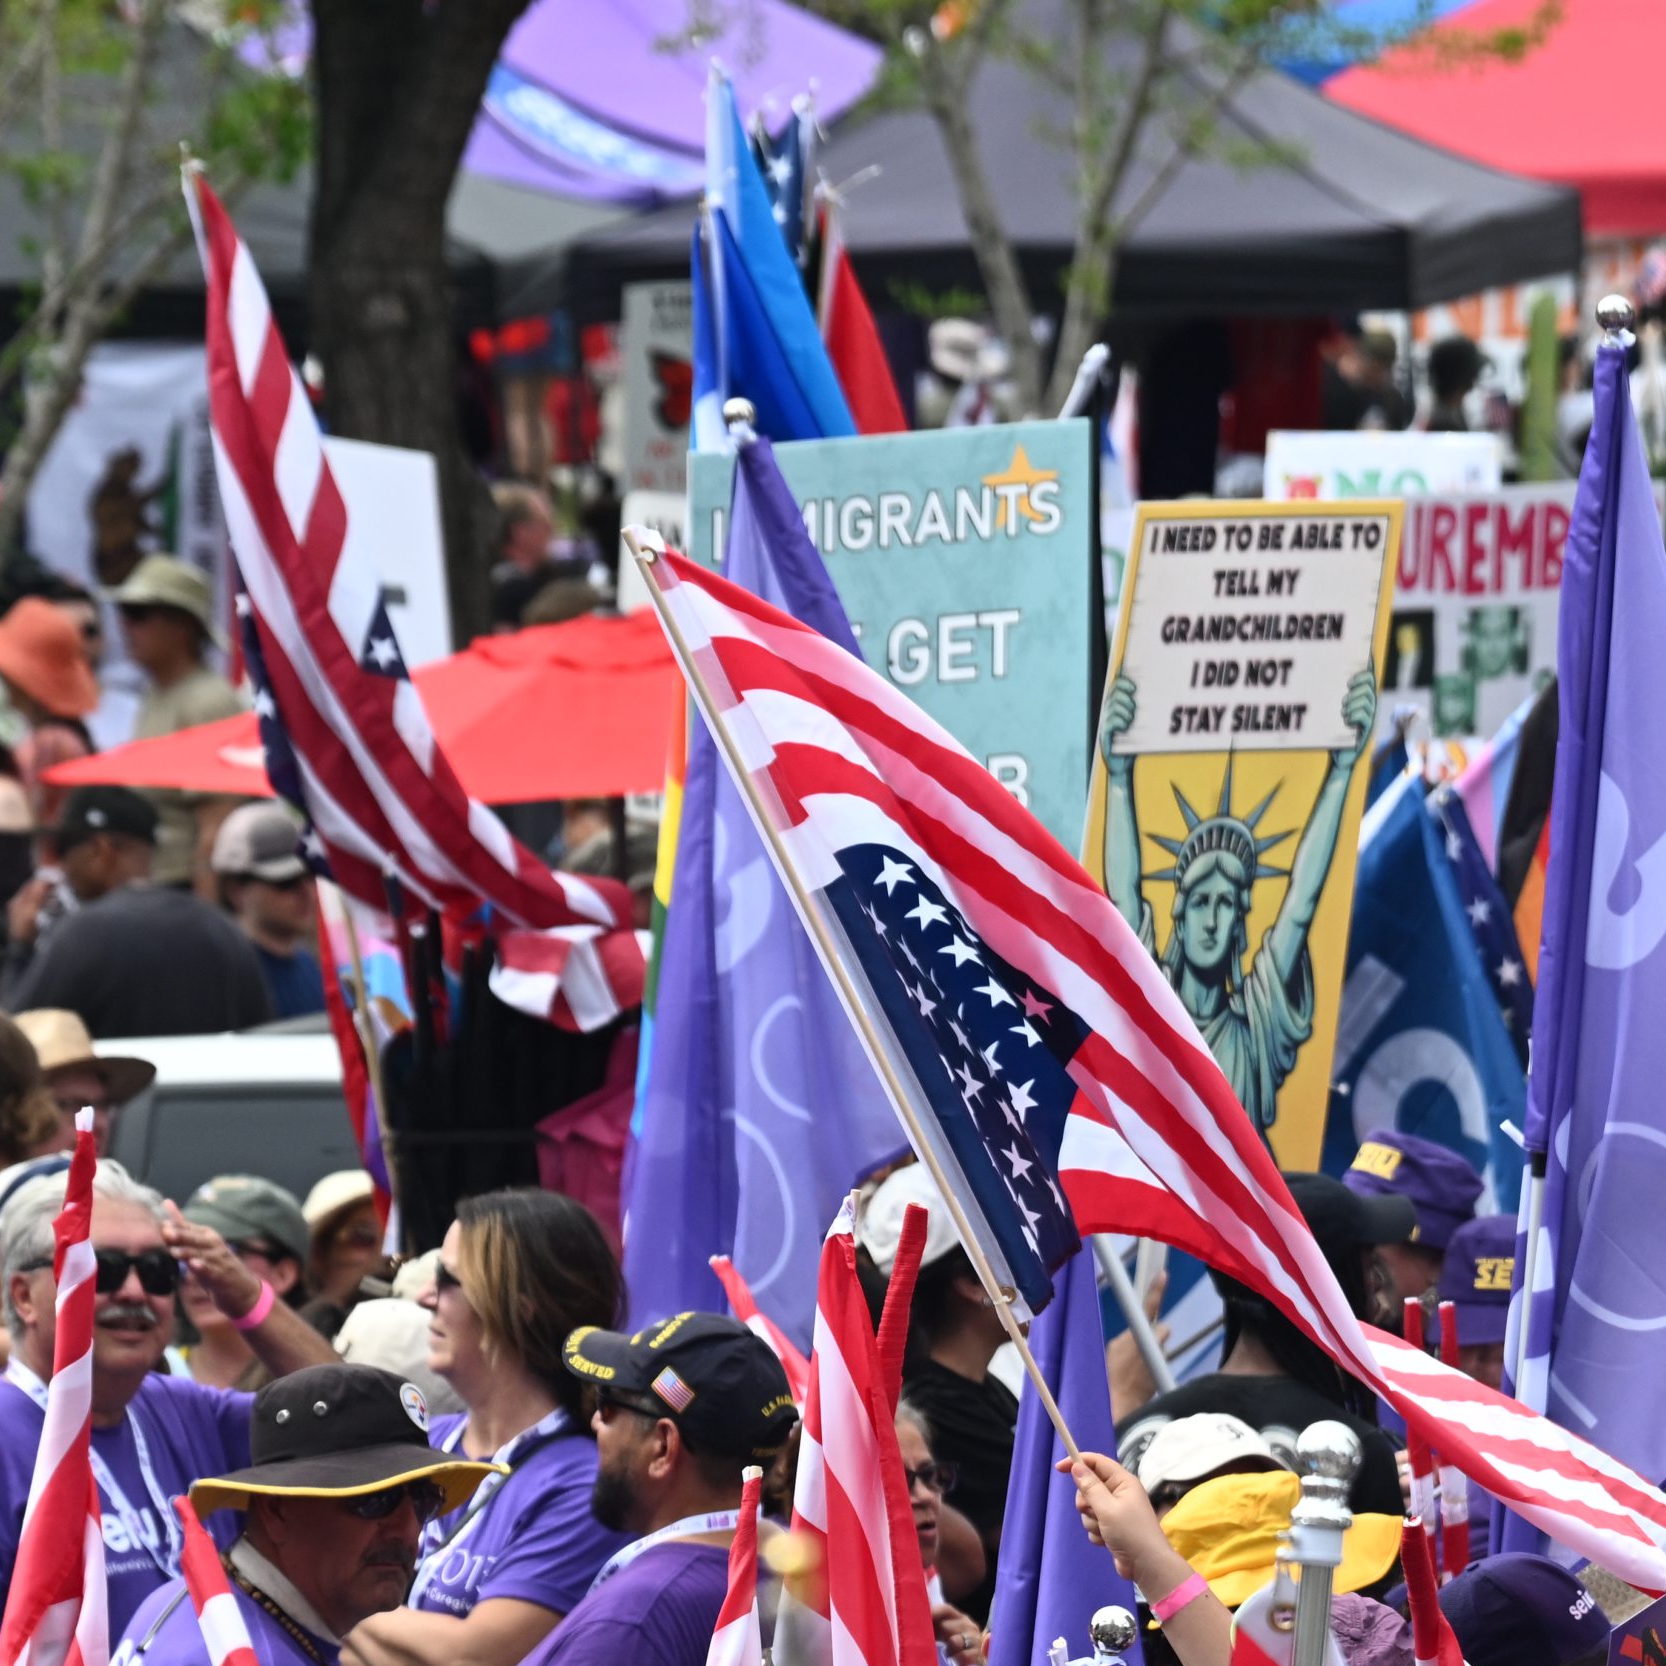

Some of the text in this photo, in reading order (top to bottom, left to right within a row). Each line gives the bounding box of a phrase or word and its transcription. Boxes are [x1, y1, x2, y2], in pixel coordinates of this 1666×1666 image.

[711, 480, 1061, 562] IIGRANTS
[1162, 526, 1217, 552] NEED
[1224, 525, 1252, 550] TO
[1257, 525, 1284, 550] BE
[1289, 524, 1344, 550] ABLE
[1351, 523, 1381, 549] TO
[1213, 569, 1299, 597] TELL MY
[1161, 614, 1344, 643] GRANDCHILDREN
[886, 608, 1021, 686] GET
[1203, 661, 1239, 686] DID
[1244, 660, 1292, 686] NOT
[1169, 705, 1306, 733] STAY SILENT
